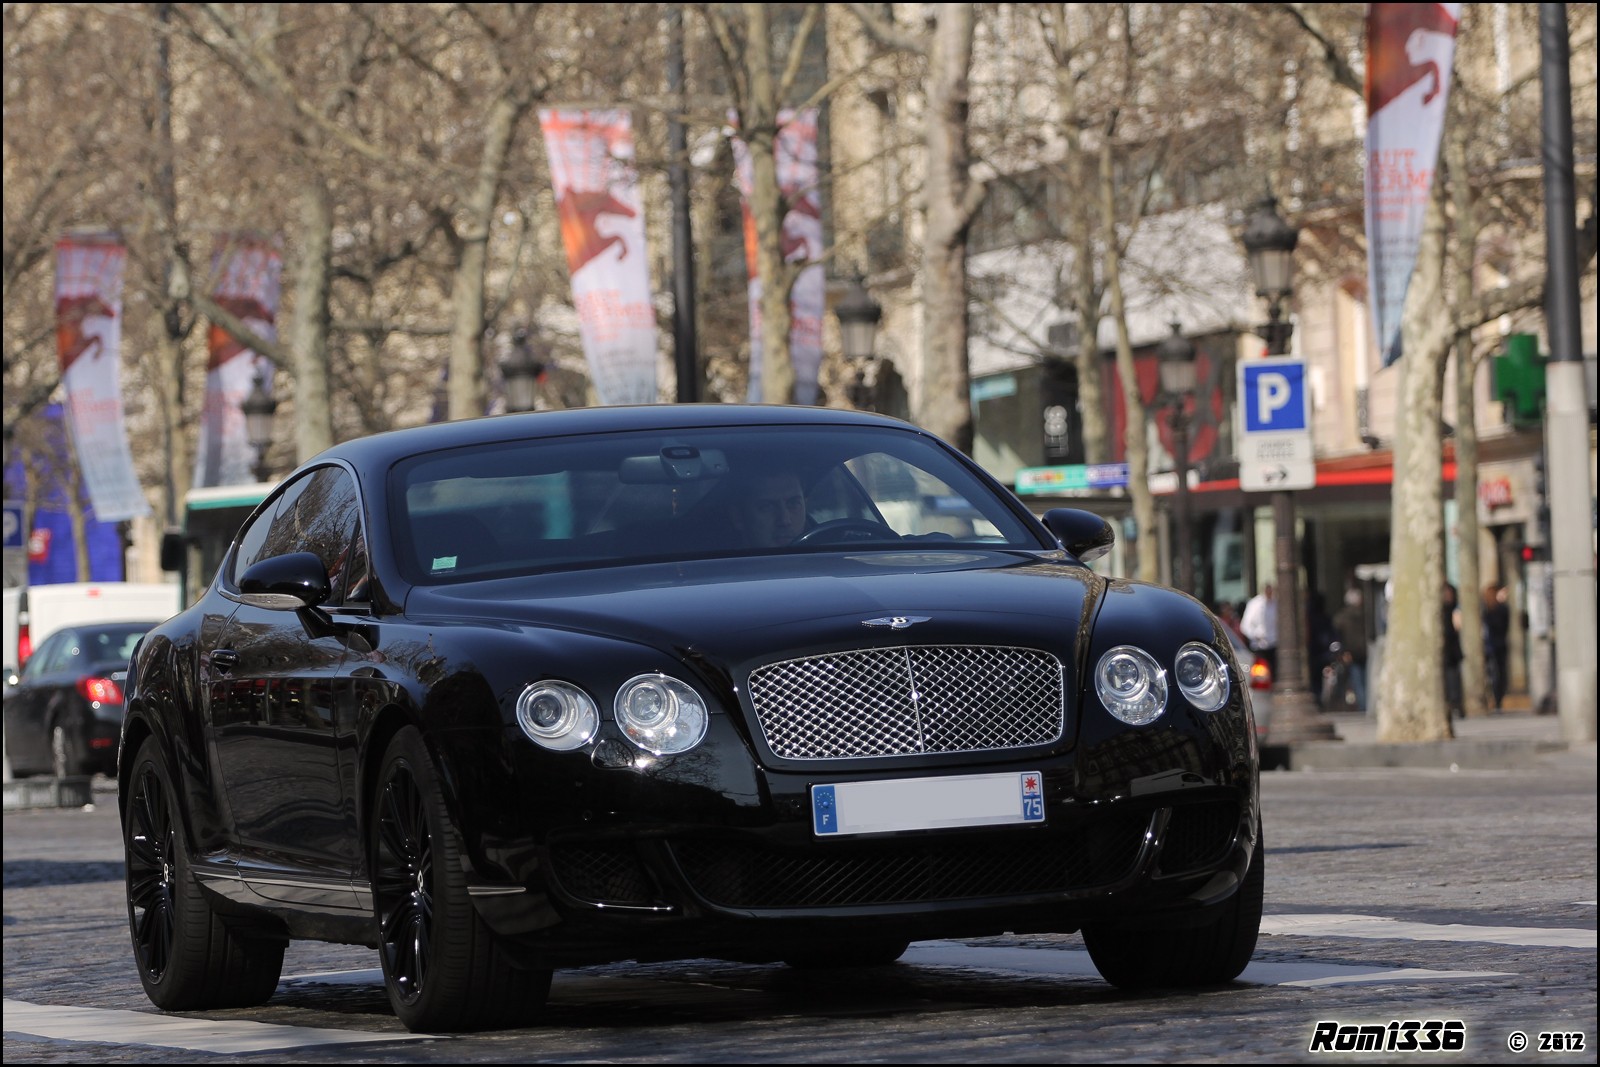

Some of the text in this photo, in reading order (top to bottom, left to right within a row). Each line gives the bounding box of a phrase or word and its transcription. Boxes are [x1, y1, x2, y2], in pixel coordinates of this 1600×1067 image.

[1257, 371, 1292, 425] P
[1023, 798, 1042, 816] 75
[822, 814, 830, 825] F
